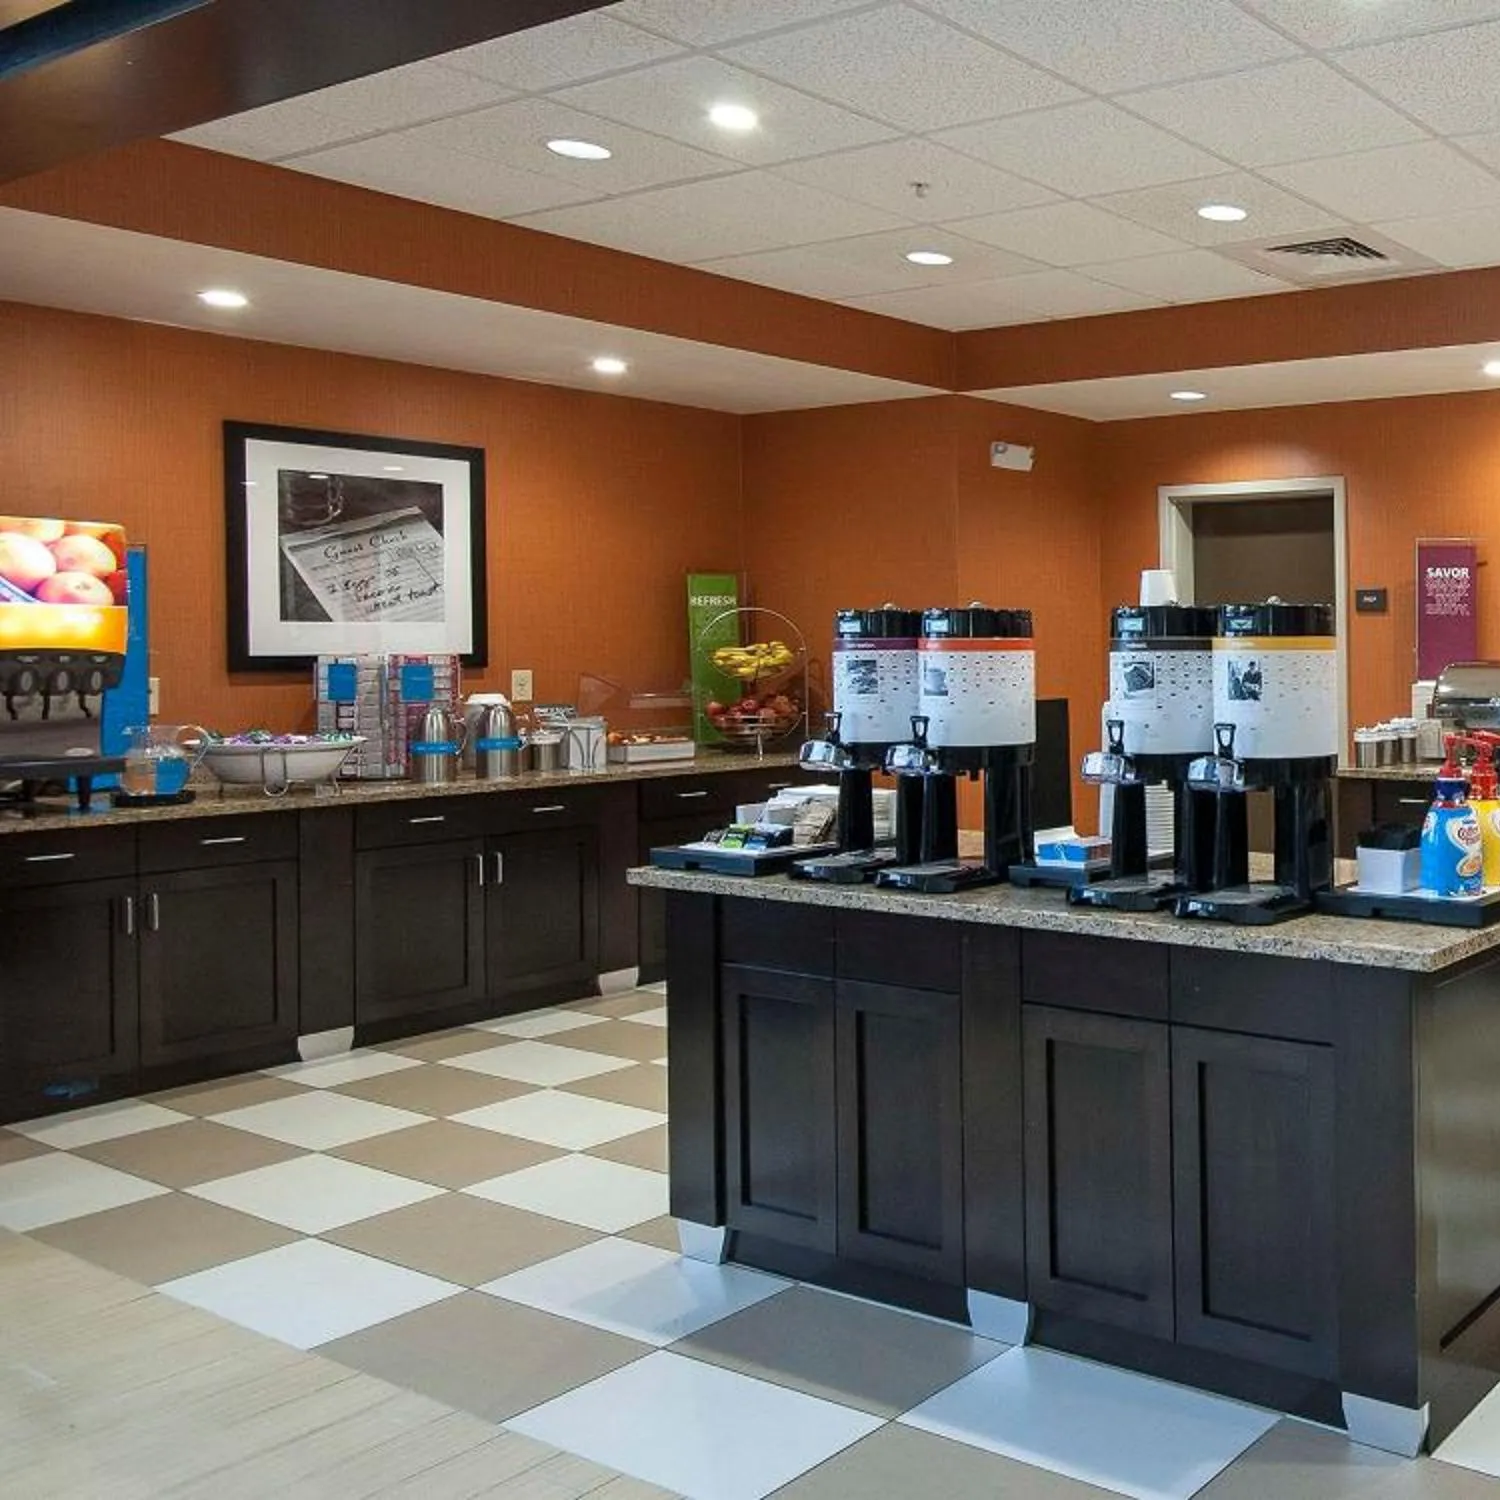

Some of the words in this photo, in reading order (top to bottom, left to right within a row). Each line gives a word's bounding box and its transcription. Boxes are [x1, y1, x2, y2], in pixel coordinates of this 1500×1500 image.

[323, 544, 364, 560] Guest
[369, 530, 408, 548] Check
[1426, 567, 1469, 578] SAVOR
[689, 595, 737, 606] REFRESH
